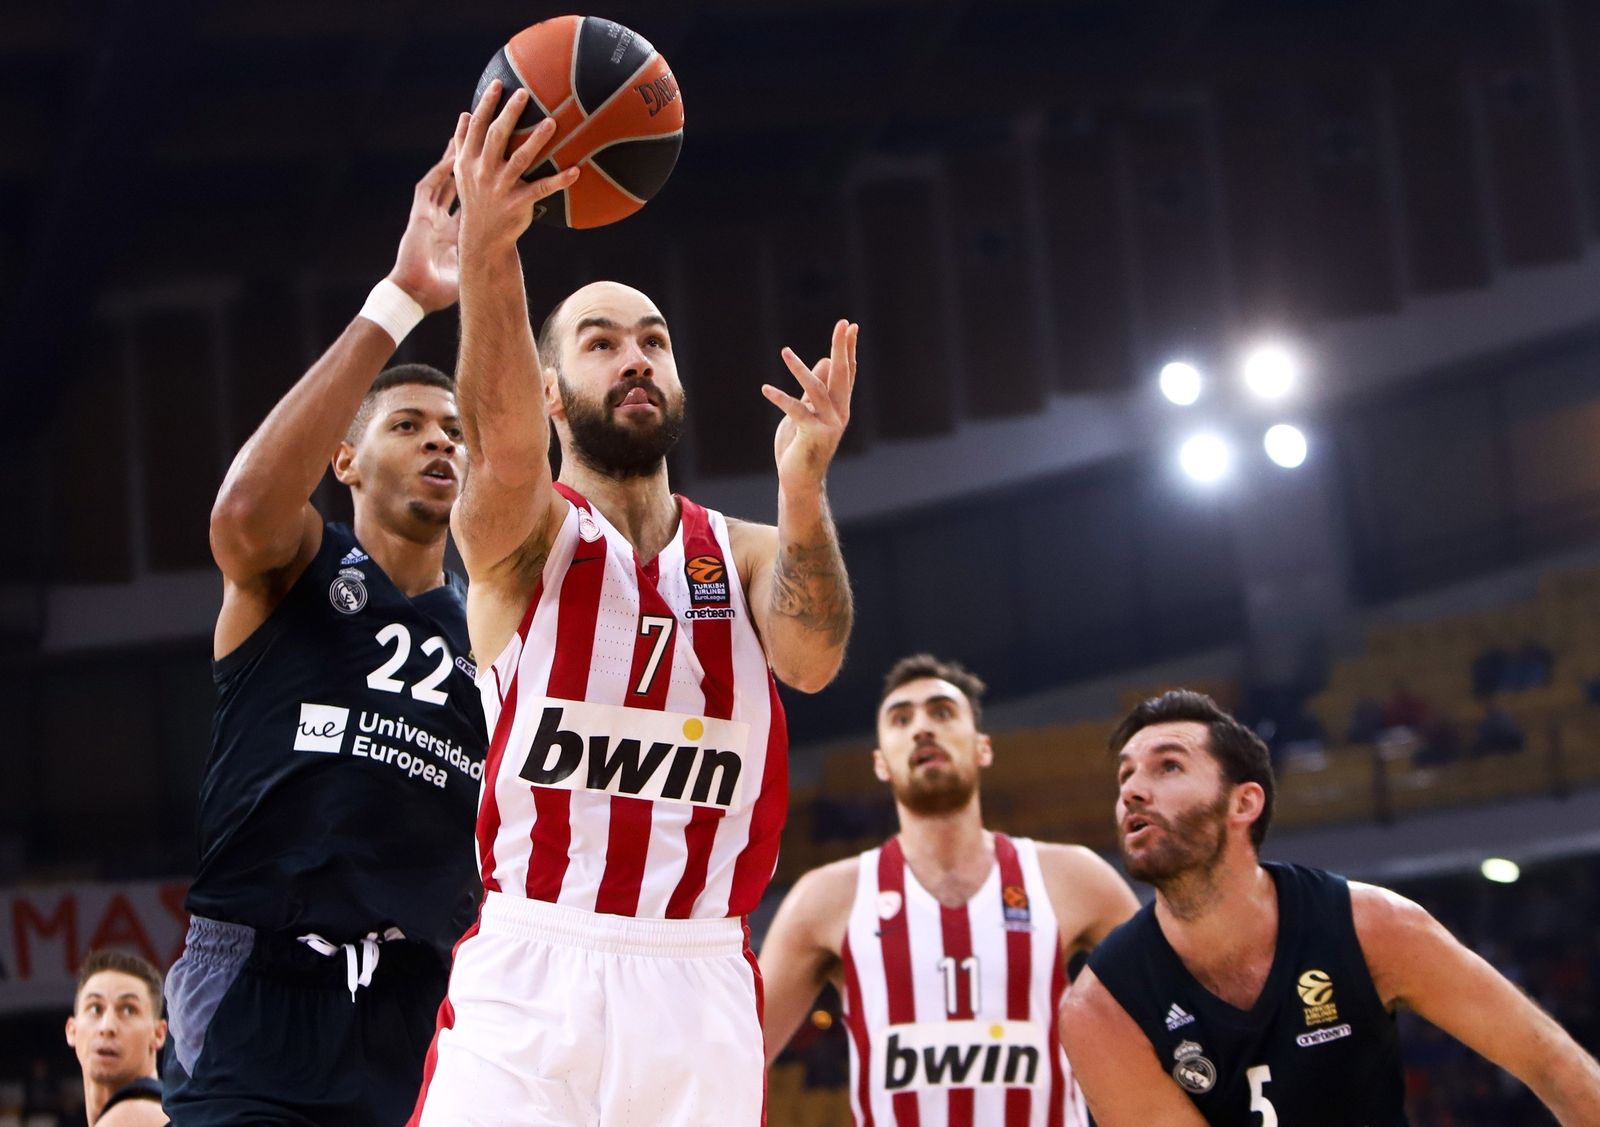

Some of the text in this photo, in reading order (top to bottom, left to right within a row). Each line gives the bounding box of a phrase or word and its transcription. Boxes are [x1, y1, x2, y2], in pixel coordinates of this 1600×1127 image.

[684, 608, 736, 619] oneteam
[692, 582, 725, 590] TURKISH
[366, 622, 454, 706] 22
[632, 616, 676, 697] 7
[351, 735, 448, 789] Europea
[358, 710, 486, 781] Universidad
[518, 707, 743, 807] bwin
[937, 956, 981, 1015] 11
[885, 1023, 1040, 1090] bwin
[1246, 1064, 1279, 1127] 5
